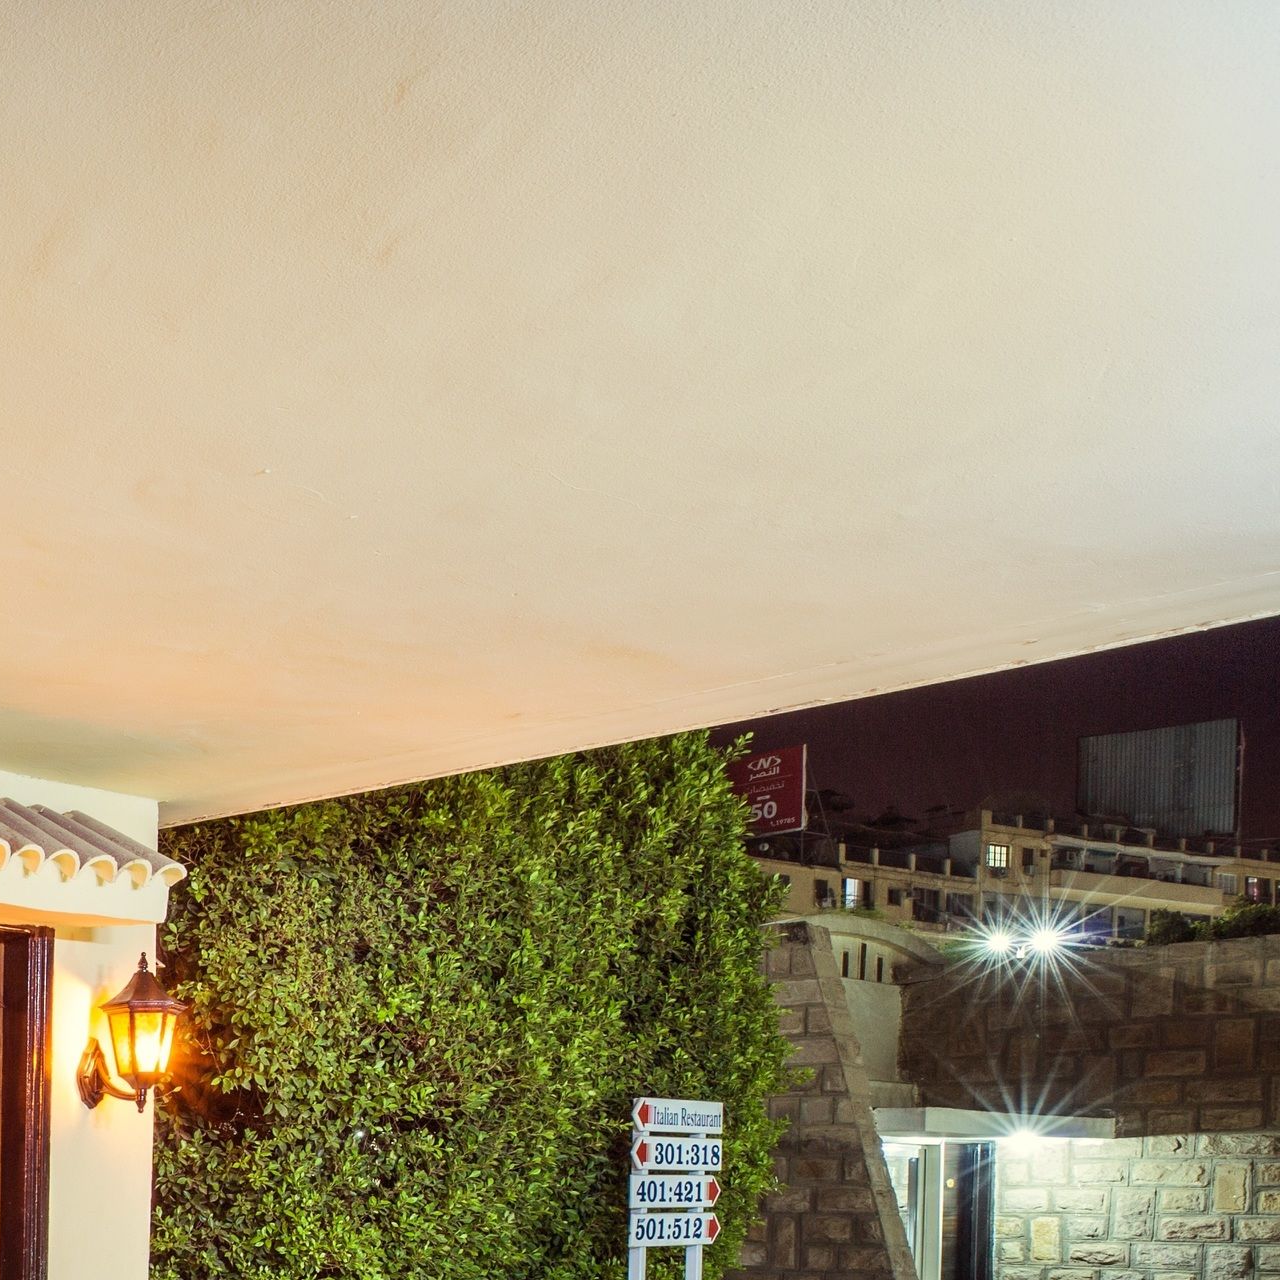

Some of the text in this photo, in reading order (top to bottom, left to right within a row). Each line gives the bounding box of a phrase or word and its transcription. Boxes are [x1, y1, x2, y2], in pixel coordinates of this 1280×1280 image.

[749, 766, 780, 781] النصر
[653, 1106, 721, 1128] Italian Restaurant
[654, 1142, 720, 1166] 301:318
[636, 1180, 703, 1203] 401:421
[635, 1217, 703, 1240] 501:512
